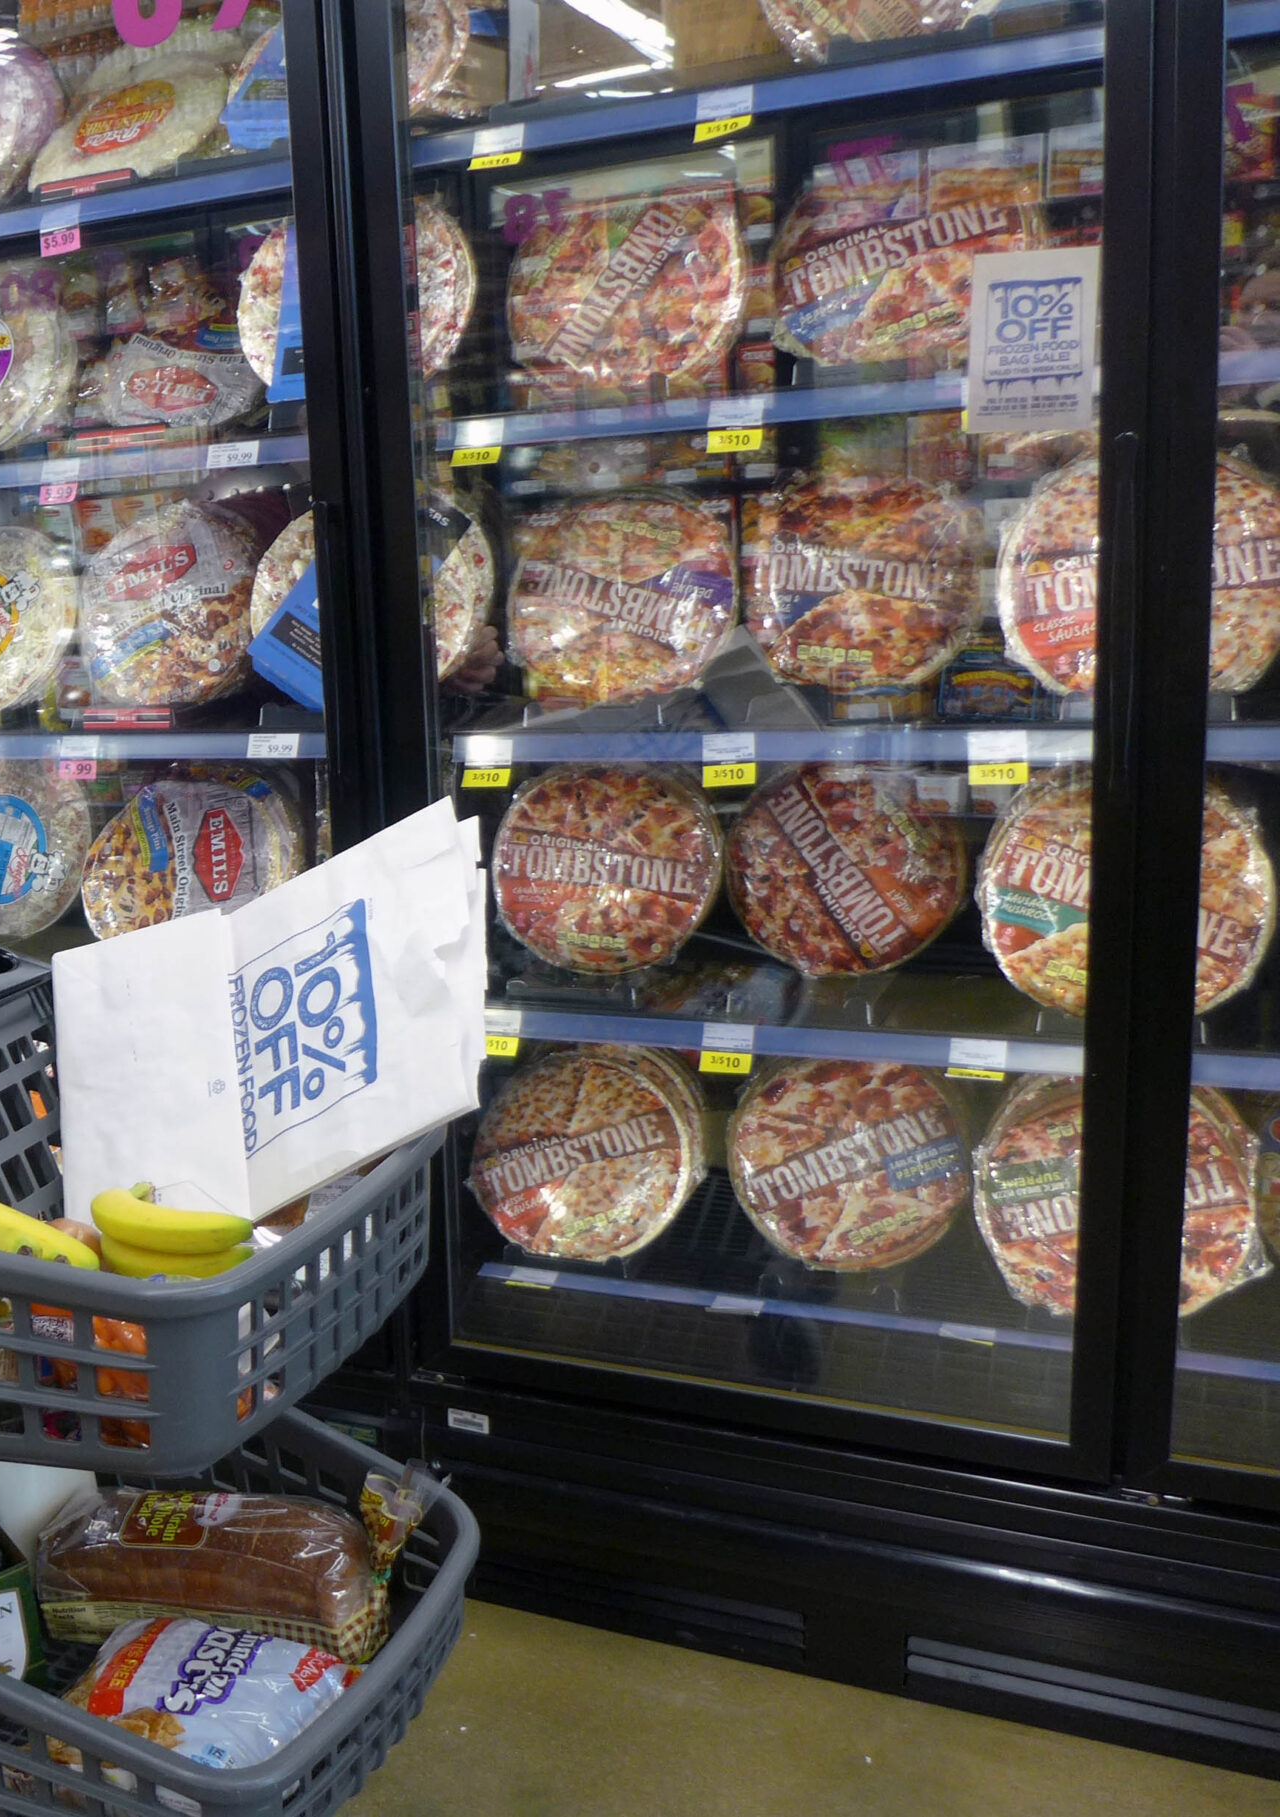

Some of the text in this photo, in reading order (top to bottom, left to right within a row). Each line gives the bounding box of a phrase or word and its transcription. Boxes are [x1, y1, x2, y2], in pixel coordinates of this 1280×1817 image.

[43, 231, 76, 250] $5.99
[784, 200, 1008, 304] TOMBSTONE
[804, 226, 889, 264] ORIGINAL
[632, 224, 686, 292] ORIGINAL
[995, 288, 1073, 319] 10%
[996, 316, 1073, 344] OFF
[988, 339, 1080, 355] FROZEN FOOD
[999, 354, 1029, 367] BAG
[609, 616, 676, 646] RIGINAL
[472, 771, 500, 783] 3/$10
[713, 767, 745, 781] 3/$10
[979, 767, 1017, 780] 3/$10
[166, 801, 181, 830] Main
[174, 834, 187, 874] Street
[530, 834, 608, 853] ORIGINAL
[208, 814, 230, 895] EMIL'S
[505, 843, 697, 896] TOMBSTONE
[772, 784, 907, 956] TOMBSTONE
[815, 877, 863, 943] ORIGINAL
[293, 931, 347, 1101] 10%
[249, 965, 302, 1116] OFF
[486, 1039, 509, 1051] /$10
[227, 974, 258, 1153] FROZEN FOOD
[709, 1055, 741, 1069] 3/$10
[483, 1112, 665, 1200] TOMBSTONE
[499, 1134, 568, 1164] ORIGINAL
[749, 1109, 948, 1209] TOMBSTONE
[136, 1494, 163, 1518] heat
[161, 1512, 188, 1542] Grain
